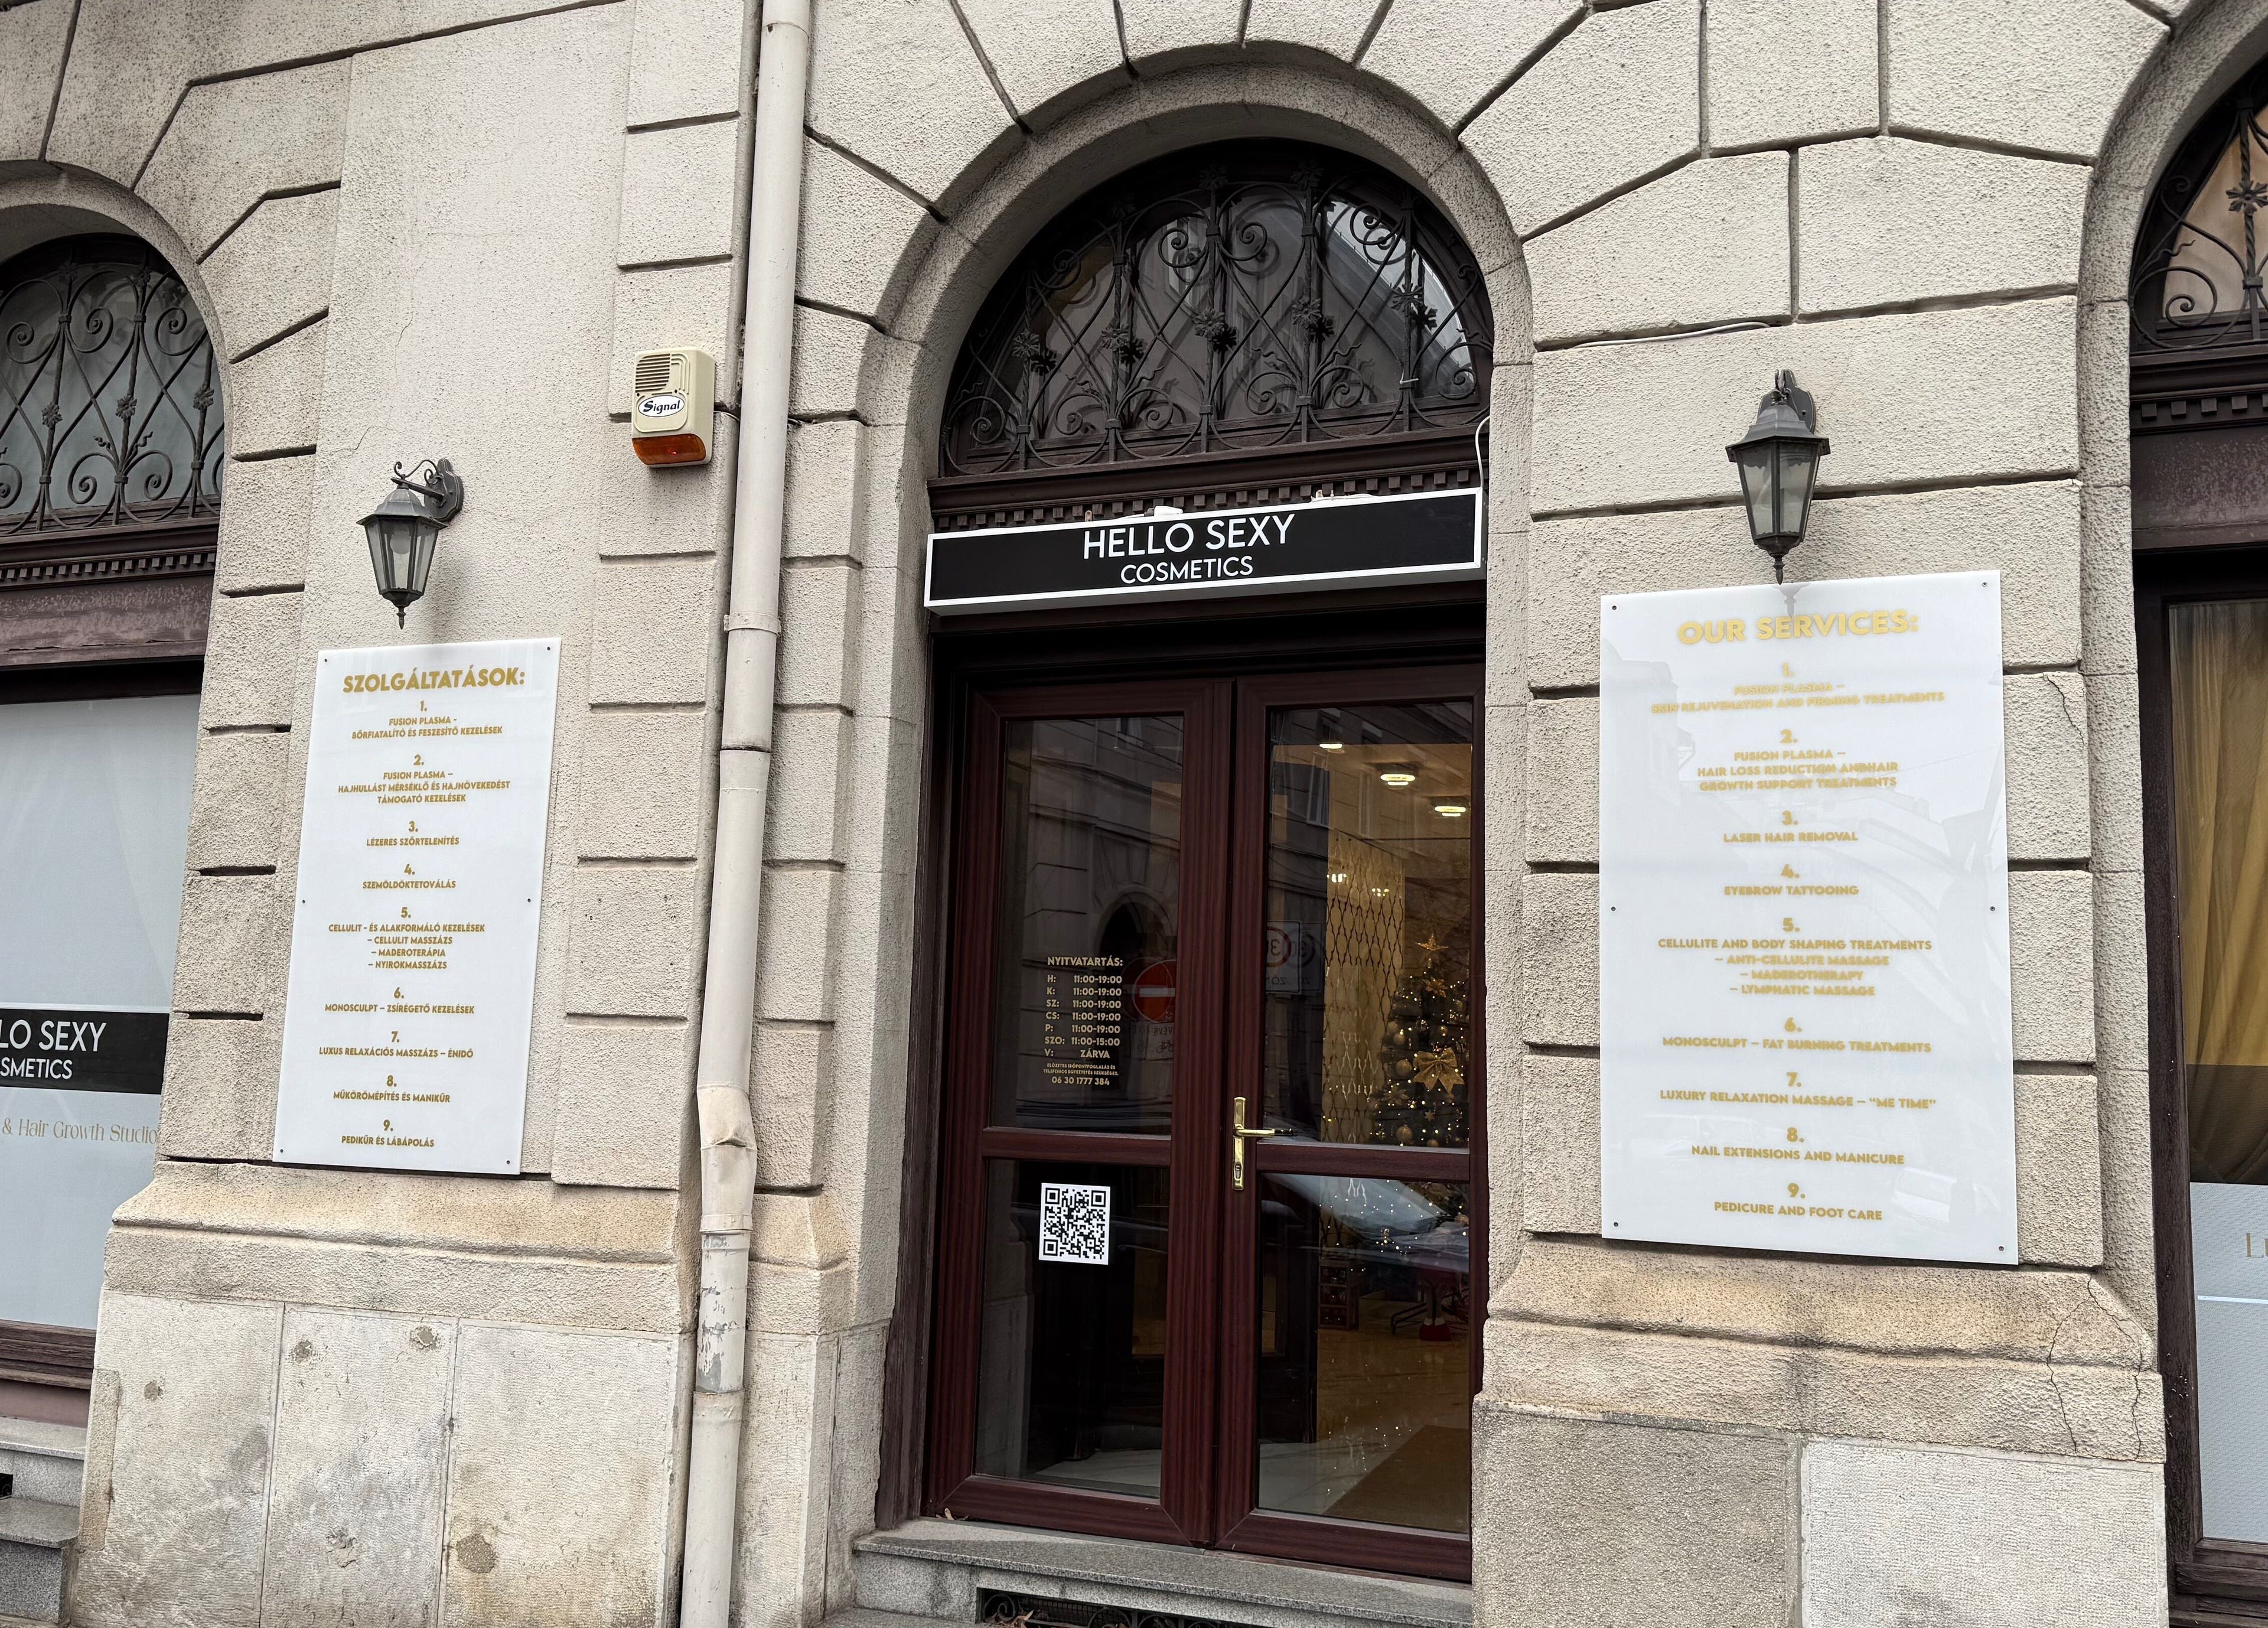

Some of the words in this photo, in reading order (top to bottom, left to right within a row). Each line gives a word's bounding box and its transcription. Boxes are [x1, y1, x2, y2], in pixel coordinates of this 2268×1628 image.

[643, 400, 680, 414] Signal
[1083, 523, 1194, 559] HELLO
[1205, 514, 1295, 550] SEXY
[1120, 555, 1253, 584] COSMETICS
[1677, 619, 1745, 644] OUR
[1757, 609, 1918, 640] SERVICES:
[1782, 662, 1794, 676] 1.
[343, 665, 524, 693] SZOLGÁLTATÁSOK:
[1734, 685, 1779, 695] FUSION
[1782, 683, 1832, 693] PLASMA
[421, 701, 427, 711] 1.
[1651, 704, 1679, 714] SKIN
[1680, 699, 1773, 712] REJUVENATION
[1777, 698, 1804, 708] AND
[1807, 696, 1860, 706] FIRMING
[1864, 692, 1944, 704] TREATMENTS
[389, 718, 417, 726] FUSION
[419, 717, 451, 725] PLASMA
[408, 728, 416, 737] ÉS
[461, 725, 503, 735] KEZELÉSEK
[1781, 730, 1797, 744] 2.
[413, 754, 424, 765] 2.
[1734, 751, 1780, 761] FUSION
[1783, 750, 1833, 760] PLASMA
[1698, 767, 1726, 776] HAIR
[1730, 766, 1761, 776] LOSS
[1764, 764, 1837, 775] REDUCTION
[338, 783, 386, 793] HAJHULLÁST
[431, 781, 440, 790] ÉS
[1699, 780, 1754, 791] GROWTH
[1757, 779, 1814, 789] SUPPORT
[1816, 777, 1896, 788] TREATMENTS
[377, 794, 422, 803] TÁMOGATÓ
[425, 793, 466, 802] KEZELÉSEK
[1783, 811, 1798, 826] 3.
[409, 820, 418, 832] 3.
[367, 837, 397, 846] LÉZERES
[1723, 833, 1761, 842] LASER
[1765, 833, 1795, 842] HAIR
[1798, 832, 1858, 841] REMOVAL
[404, 864, 415, 875] 4.
[1782, 865, 1800, 878] 4.
[1724, 886, 1783, 896] EYEBROW
[1787, 885, 1859, 896] TATTOOING
[401, 907, 411, 918] 5.
[369, 923, 377, 932] ÉS
[380, 922, 440, 932] ALAKFORMÁLÓ
[442, 922, 485, 932] KEZELÉSEK
[1783, 918, 1800, 933] 5.
[411, 935, 452, 944] MASSZÁZS
[1658, 939, 1718, 949] CELLULITE
[1722, 939, 1748, 949] AND
[1752, 940, 1785, 949] BODY
[1790, 940, 1846, 950] SHAPING
[1850, 940, 1931, 950] TREATMENTS
[379, 948, 445, 956] MADEROTERÁPIA
[376, 960, 447, 969] NYIROKMASSZÁZS
[1047, 955, 1123, 966] NYITVATARTÁS:
[1728, 955, 1824, 966] ANTI-CELLULITE
[1827, 955, 1889, 966] MASSAGE
[1047, 975, 1056, 983] H:
[1074, 975, 1122, 984] 11:00-19:00
[1751, 970, 1863, 981] MADEROTHERAPY
[394, 987, 404, 999] 6.
[1047, 987, 1055, 995] K:
[1073, 988, 1122, 997] 11:00-19:00
[1742, 984, 1810, 995] LYMPHATIC
[1813, 985, 1875, 996] MASSAGE
[325, 1004, 378, 1012] MONOSCULPT
[432, 1004, 474, 1014] KEZELÉSEK
[1046, 999, 1059, 1008] SZ:
[1073, 1000, 1122, 1009] 11:00-19:00
[1045, 1011, 1060, 1020] CS:
[1072, 1012, 1121, 1021] 11:00-19:00
[1071, 1025, 1120, 1034] 11:00-19:00
[1785, 1018, 1802, 1033] 6.
[38, 1020, 107, 1051] SEXY
[392, 1031, 399, 1043] 7.
[1044, 1036, 1064, 1044] SZO:
[1071, 1037, 1120, 1046] 11:00-15:00
[1663, 1037, 1748, 1048] MONOSCULPT
[1763, 1039, 1784, 1049] FAT
[1787, 1040, 1846, 1051] BURNING
[1849, 1041, 1931, 1053] TREATMENTS
[319, 1047, 343, 1055] LUXUS
[345, 1047, 394, 1056] RELAXÁCIÓS
[396, 1047, 438, 1057] MASSZÁZS
[1044, 1049, 1054, 1057] V:
[1080, 1048, 1110, 1059] ZÁRVA
[387, 1075, 397, 1087] 8.
[1064, 1076, 1074, 1085] 30
[1094, 1077, 1110, 1086] 384
[1788, 1072, 1801, 1087] 7.
[402, 1092, 410, 1101] ÉS
[1660, 1090, 1706, 1100] LUXURY
[1710, 1092, 1789, 1104] RELAXATION
[1792, 1096, 1853, 1106] MASSAGE
[2, 1118, 12, 1136] &
[19, 1119, 49, 1137] Hair
[53, 1121, 105, 1141] Growth
[110, 1124, 158, 1144] Studio
[383, 1119, 393, 1131] 9.
[376, 1135, 384, 1145] ÉS
[387, 1136, 434, 1147] LÁBÁPOLÁS
[1787, 1128, 1804, 1142] 8.
[1692, 1147, 1720, 1156] NAIL
[1723, 1147, 1800, 1160] EXTENSIONS
[1805, 1152, 1833, 1162] AND
[1836, 1154, 1904, 1165] MANICURE
[1788, 1183, 1805, 1199] 9.
[1715, 1202, 1774, 1215] PEDICURE
[1778, 1206, 1806, 1216] AND
[1810, 1207, 1844, 1218] FOOT
[1848, 1209, 1882, 1220] CARE
